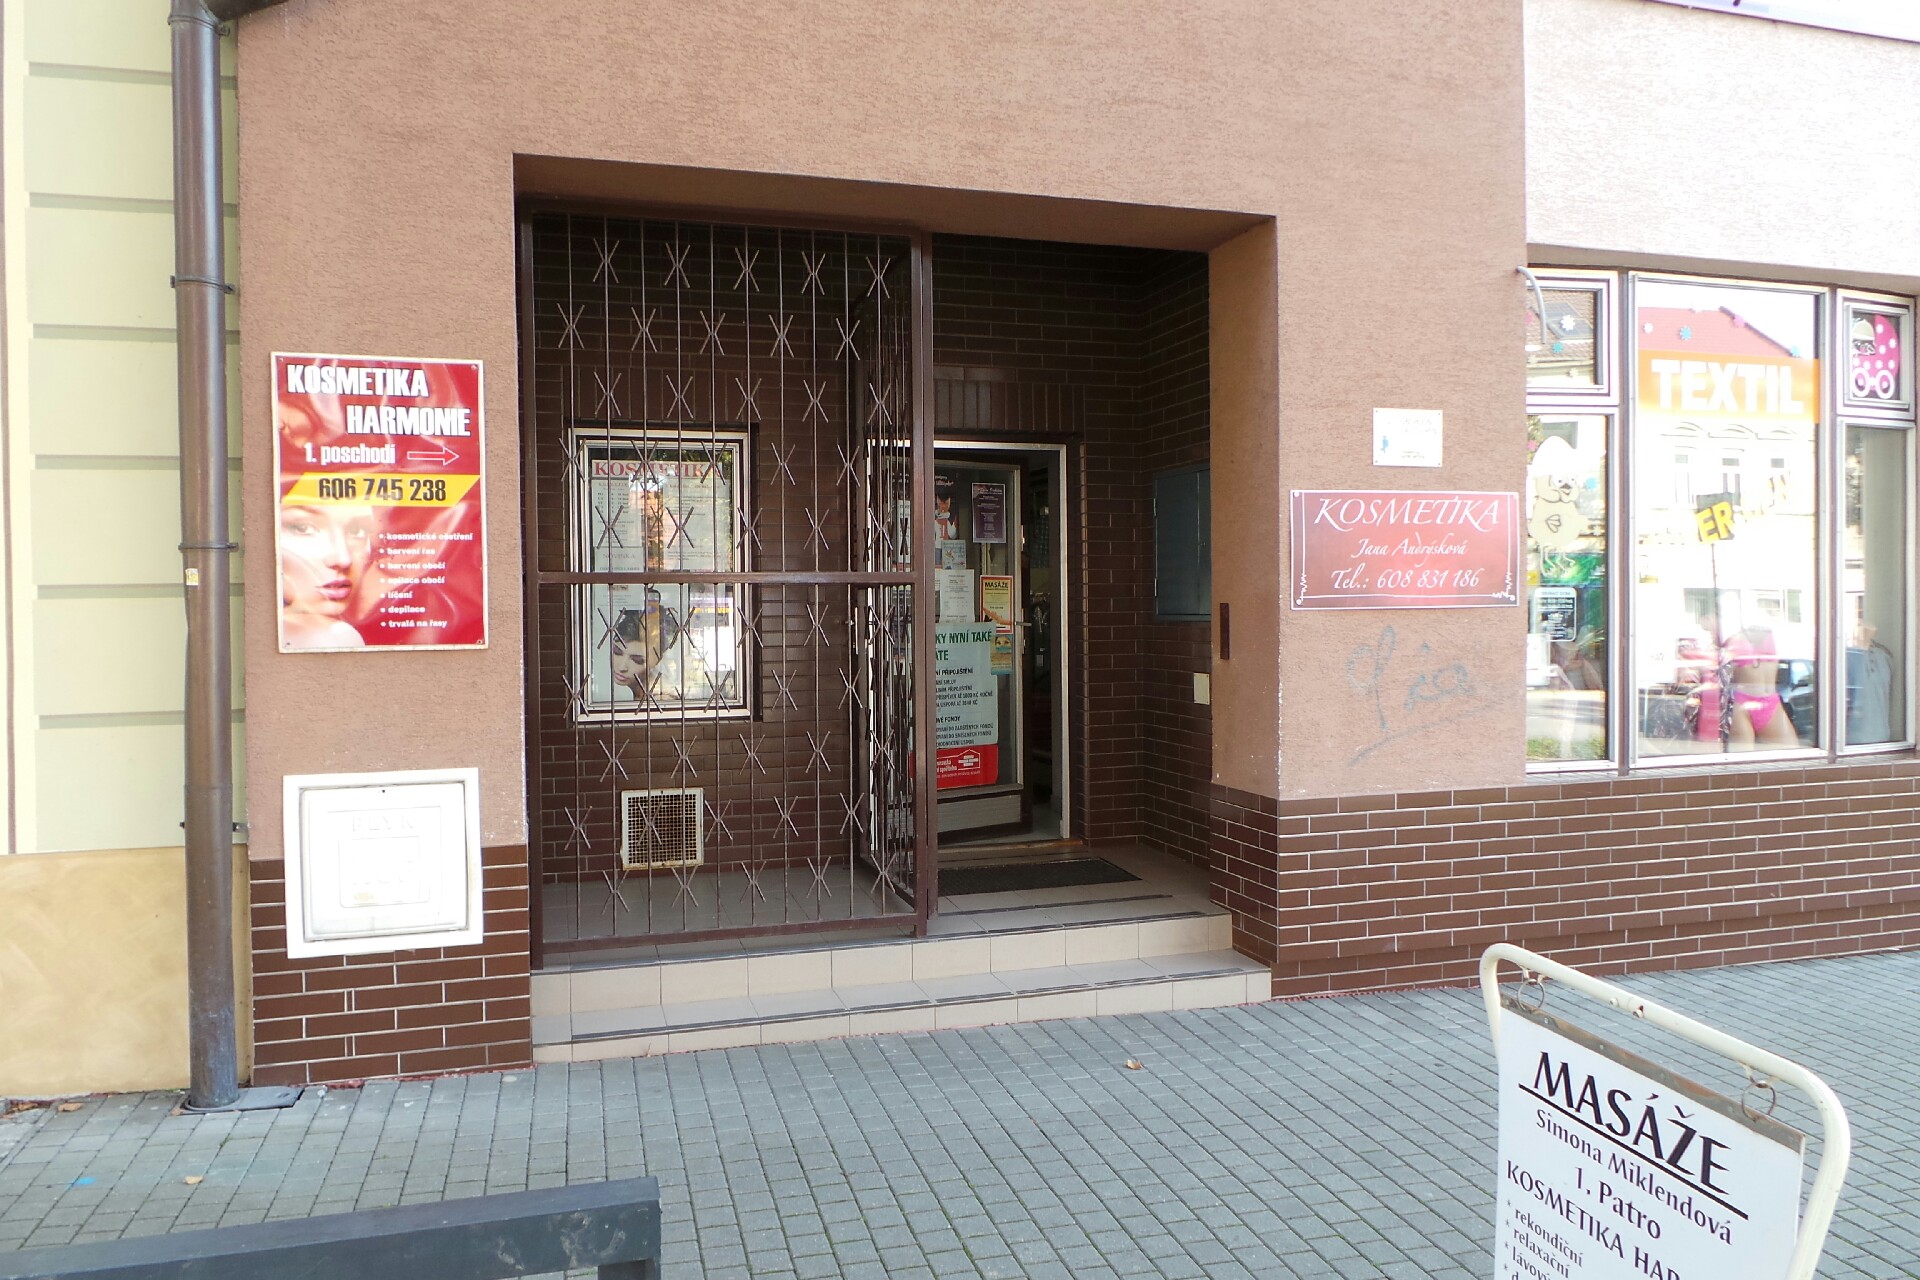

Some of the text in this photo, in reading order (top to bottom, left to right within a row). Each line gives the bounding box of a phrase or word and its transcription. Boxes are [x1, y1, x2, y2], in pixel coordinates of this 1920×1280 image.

[286, 364, 429, 397] KOSMETIKA
[1651, 358, 1804, 414] TEXTIL
[346, 405, 471, 436] HARMONIE
[304, 442, 396, 466] 1. poschodí
[318, 478, 447, 501] 606 745 238
[1314, 495, 1499, 532] KOSMETIKA
[386, 532, 437, 540] kosmetické
[1351, 531, 1468, 568] Jana Andrýsková
[387, 547, 420, 555] barvení
[422, 561, 446, 569] obočí
[1377, 569, 1413, 589] 608
[1417, 569, 1446, 589] 831
[1452, 567, 1486, 588] 186
[421, 576, 445, 584] obočí
[985, 580, 1009, 588] MASÁŽE
[388, 605, 426, 614] depilace
[388, 619, 415, 627] trvalá
[950, 629, 969, 643] NYNÍ
[971, 628, 992, 643] TAKÉ
[1533, 1050, 1732, 1196] MASÁŽE
[1536, 1108, 1733, 1245] Simona Miklendová
[1507, 1160, 1625, 1259] KOSMETIKA
[1575, 1166, 1662, 1239] 1. Patro
[1515, 1208, 1584, 1268] rekondiční
[1513, 1227, 1570, 1279] relaxační
